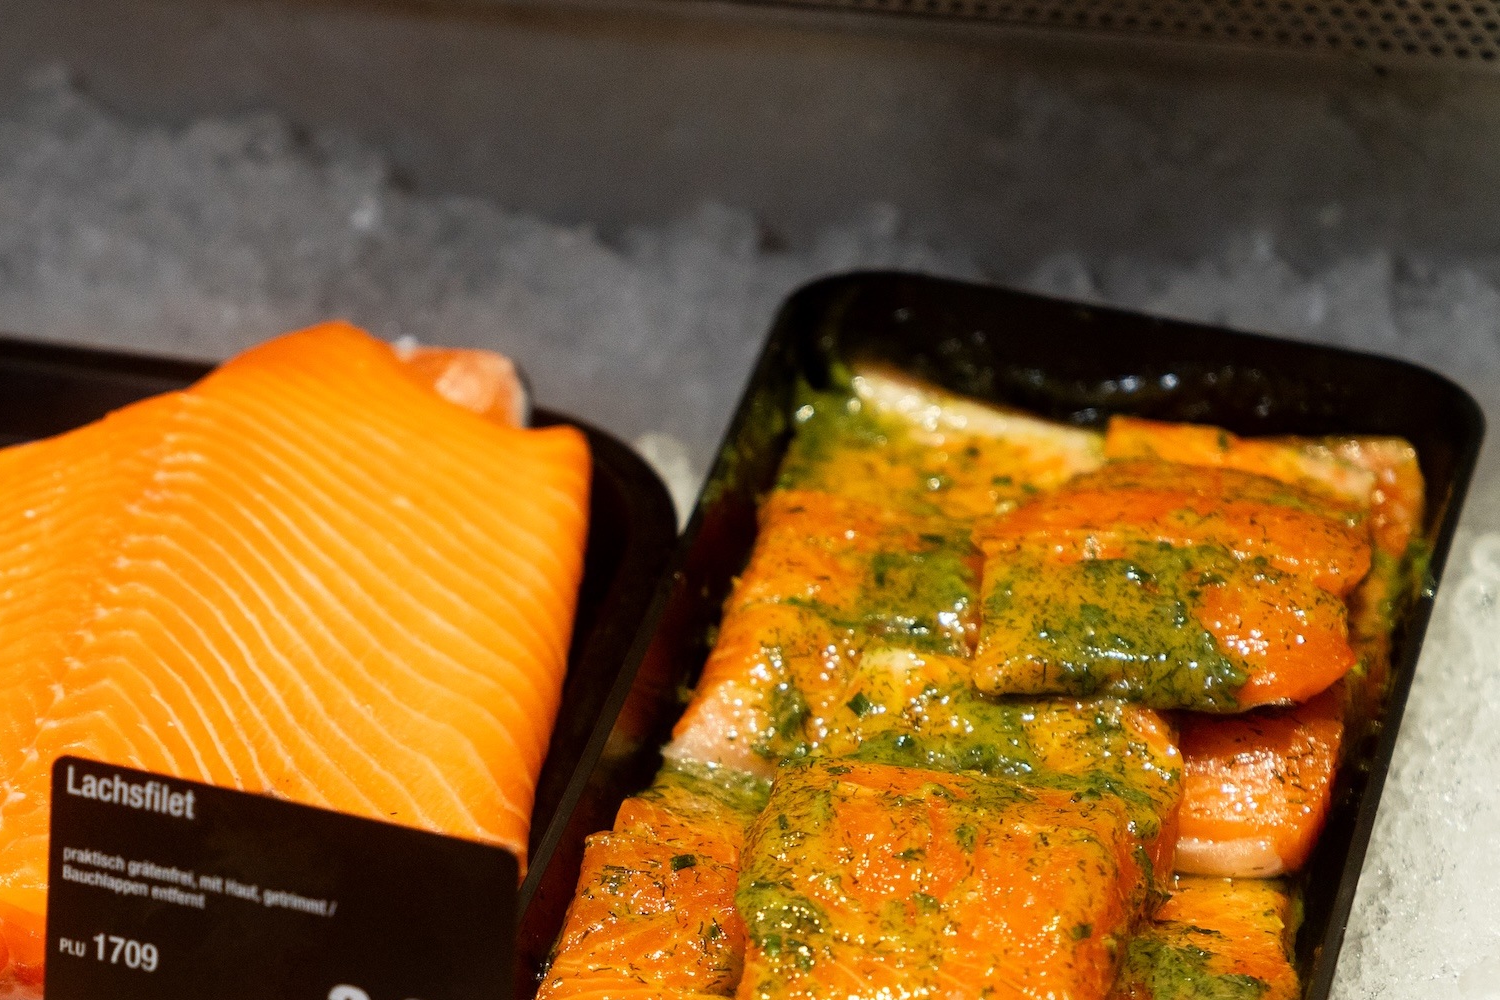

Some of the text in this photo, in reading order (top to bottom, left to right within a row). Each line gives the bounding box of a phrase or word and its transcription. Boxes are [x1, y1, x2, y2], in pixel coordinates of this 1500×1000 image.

[66, 765, 195, 820] Lachsfilet
[62, 863, 206, 911] Bauchlappen entfernt
[63, 846, 126, 873] praktisch
[199, 874, 223, 894] mit
[59, 932, 159, 973] PLU 1709
